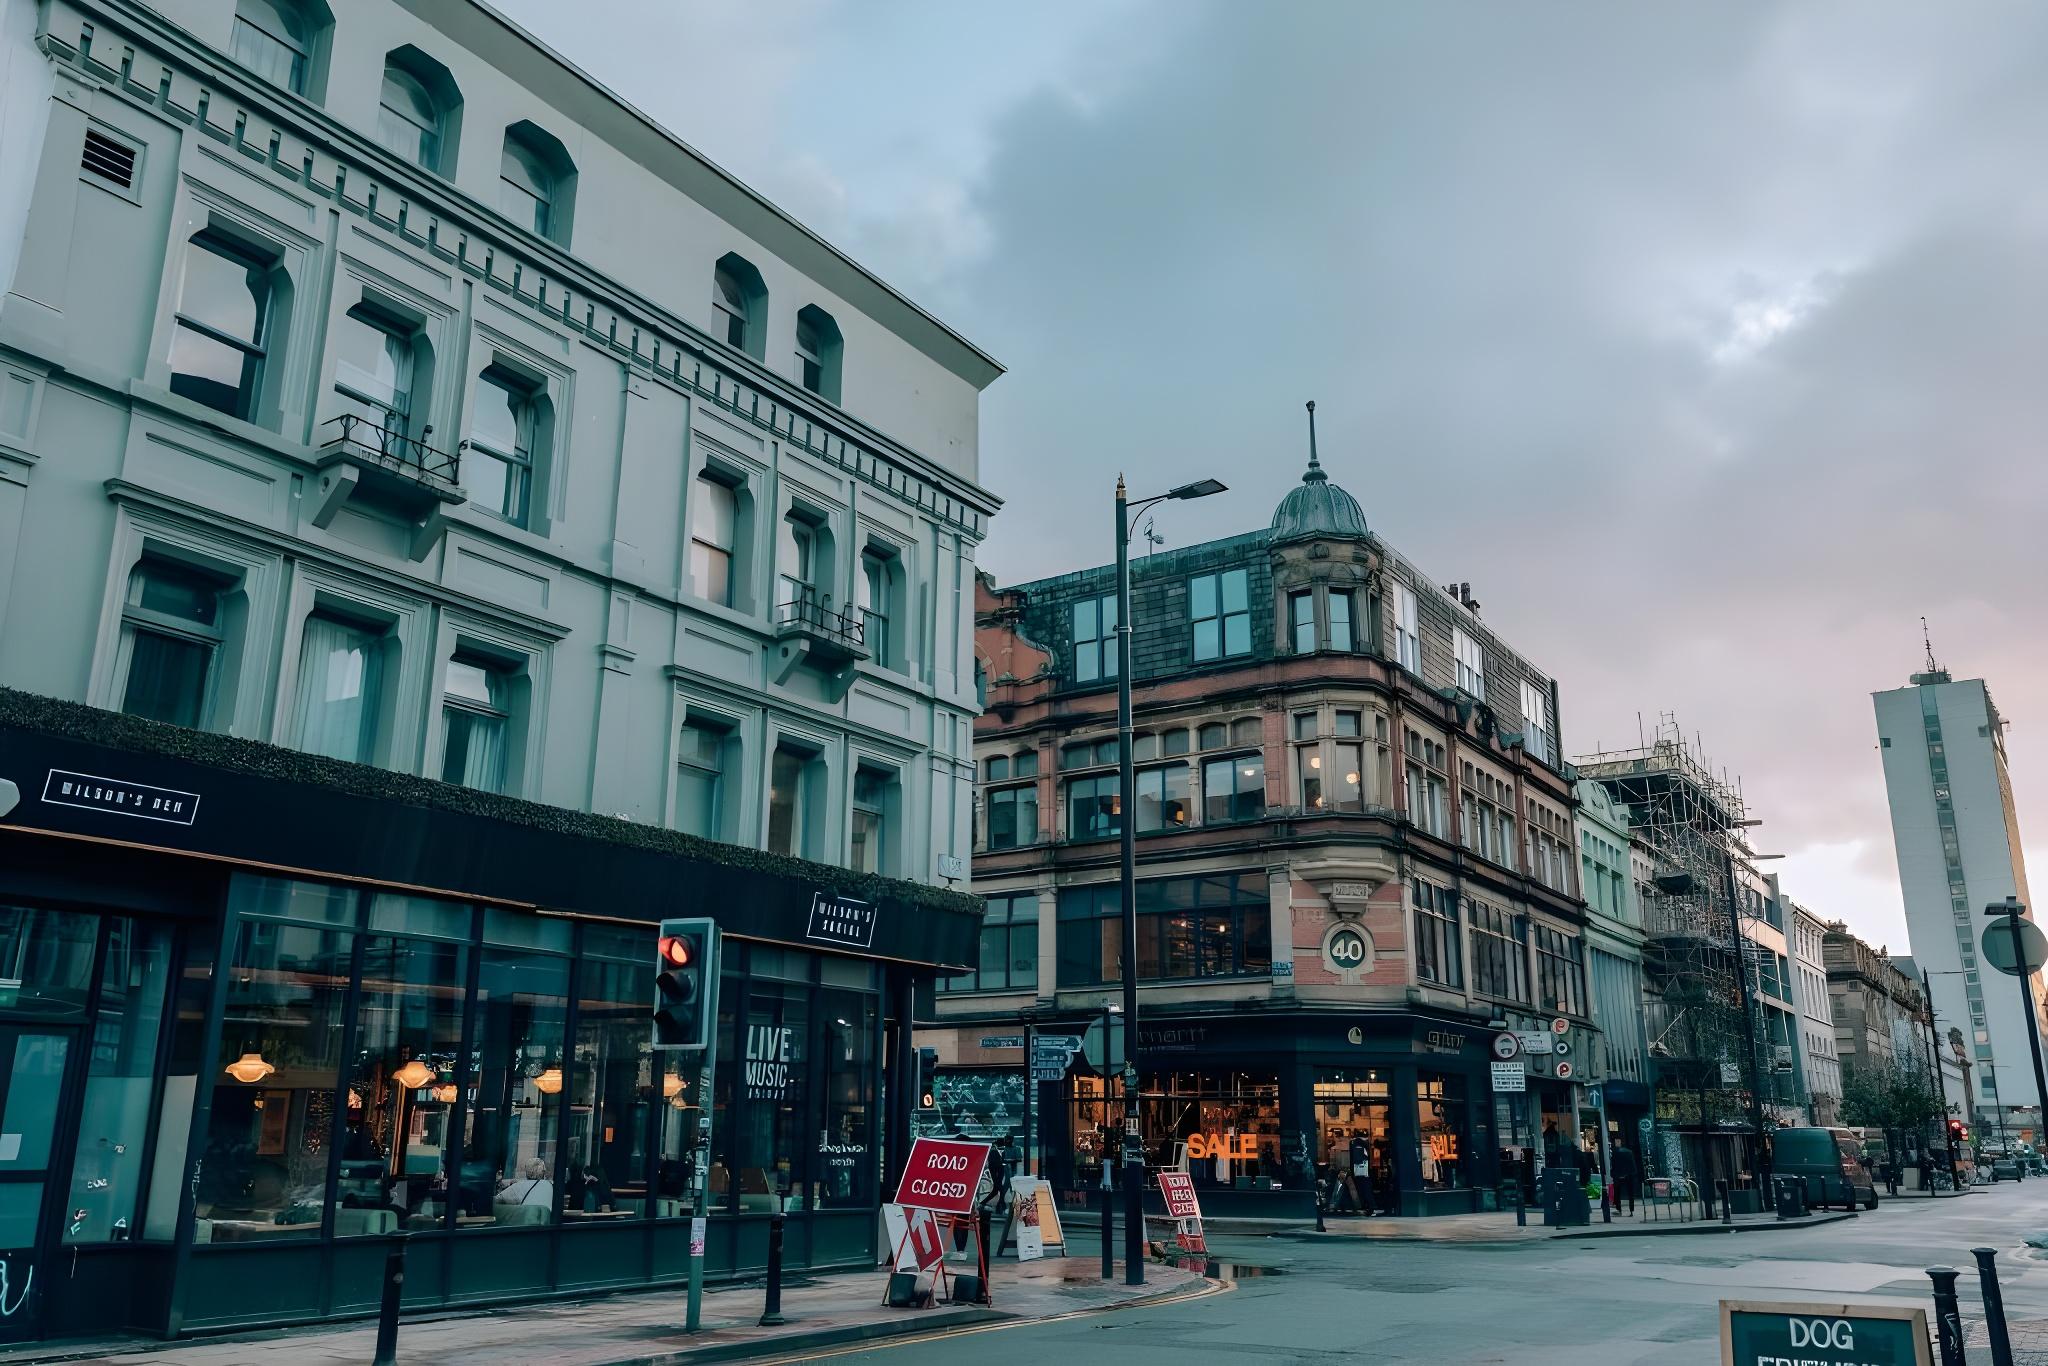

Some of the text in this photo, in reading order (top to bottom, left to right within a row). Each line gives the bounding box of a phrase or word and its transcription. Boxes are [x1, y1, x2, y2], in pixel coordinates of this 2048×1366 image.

[1332, 938, 1363, 961] 40
[746, 1025, 792, 1062] LIVE
[745, 1061, 788, 1088] MUSIC
[1187, 1133, 1259, 1159] SALE
[1430, 1134, 1458, 1160] SALE
[927, 1153, 968, 1171] ROAD
[911, 1178, 967, 1199] CLOSED
[1789, 1317, 1854, 1351] DOG
